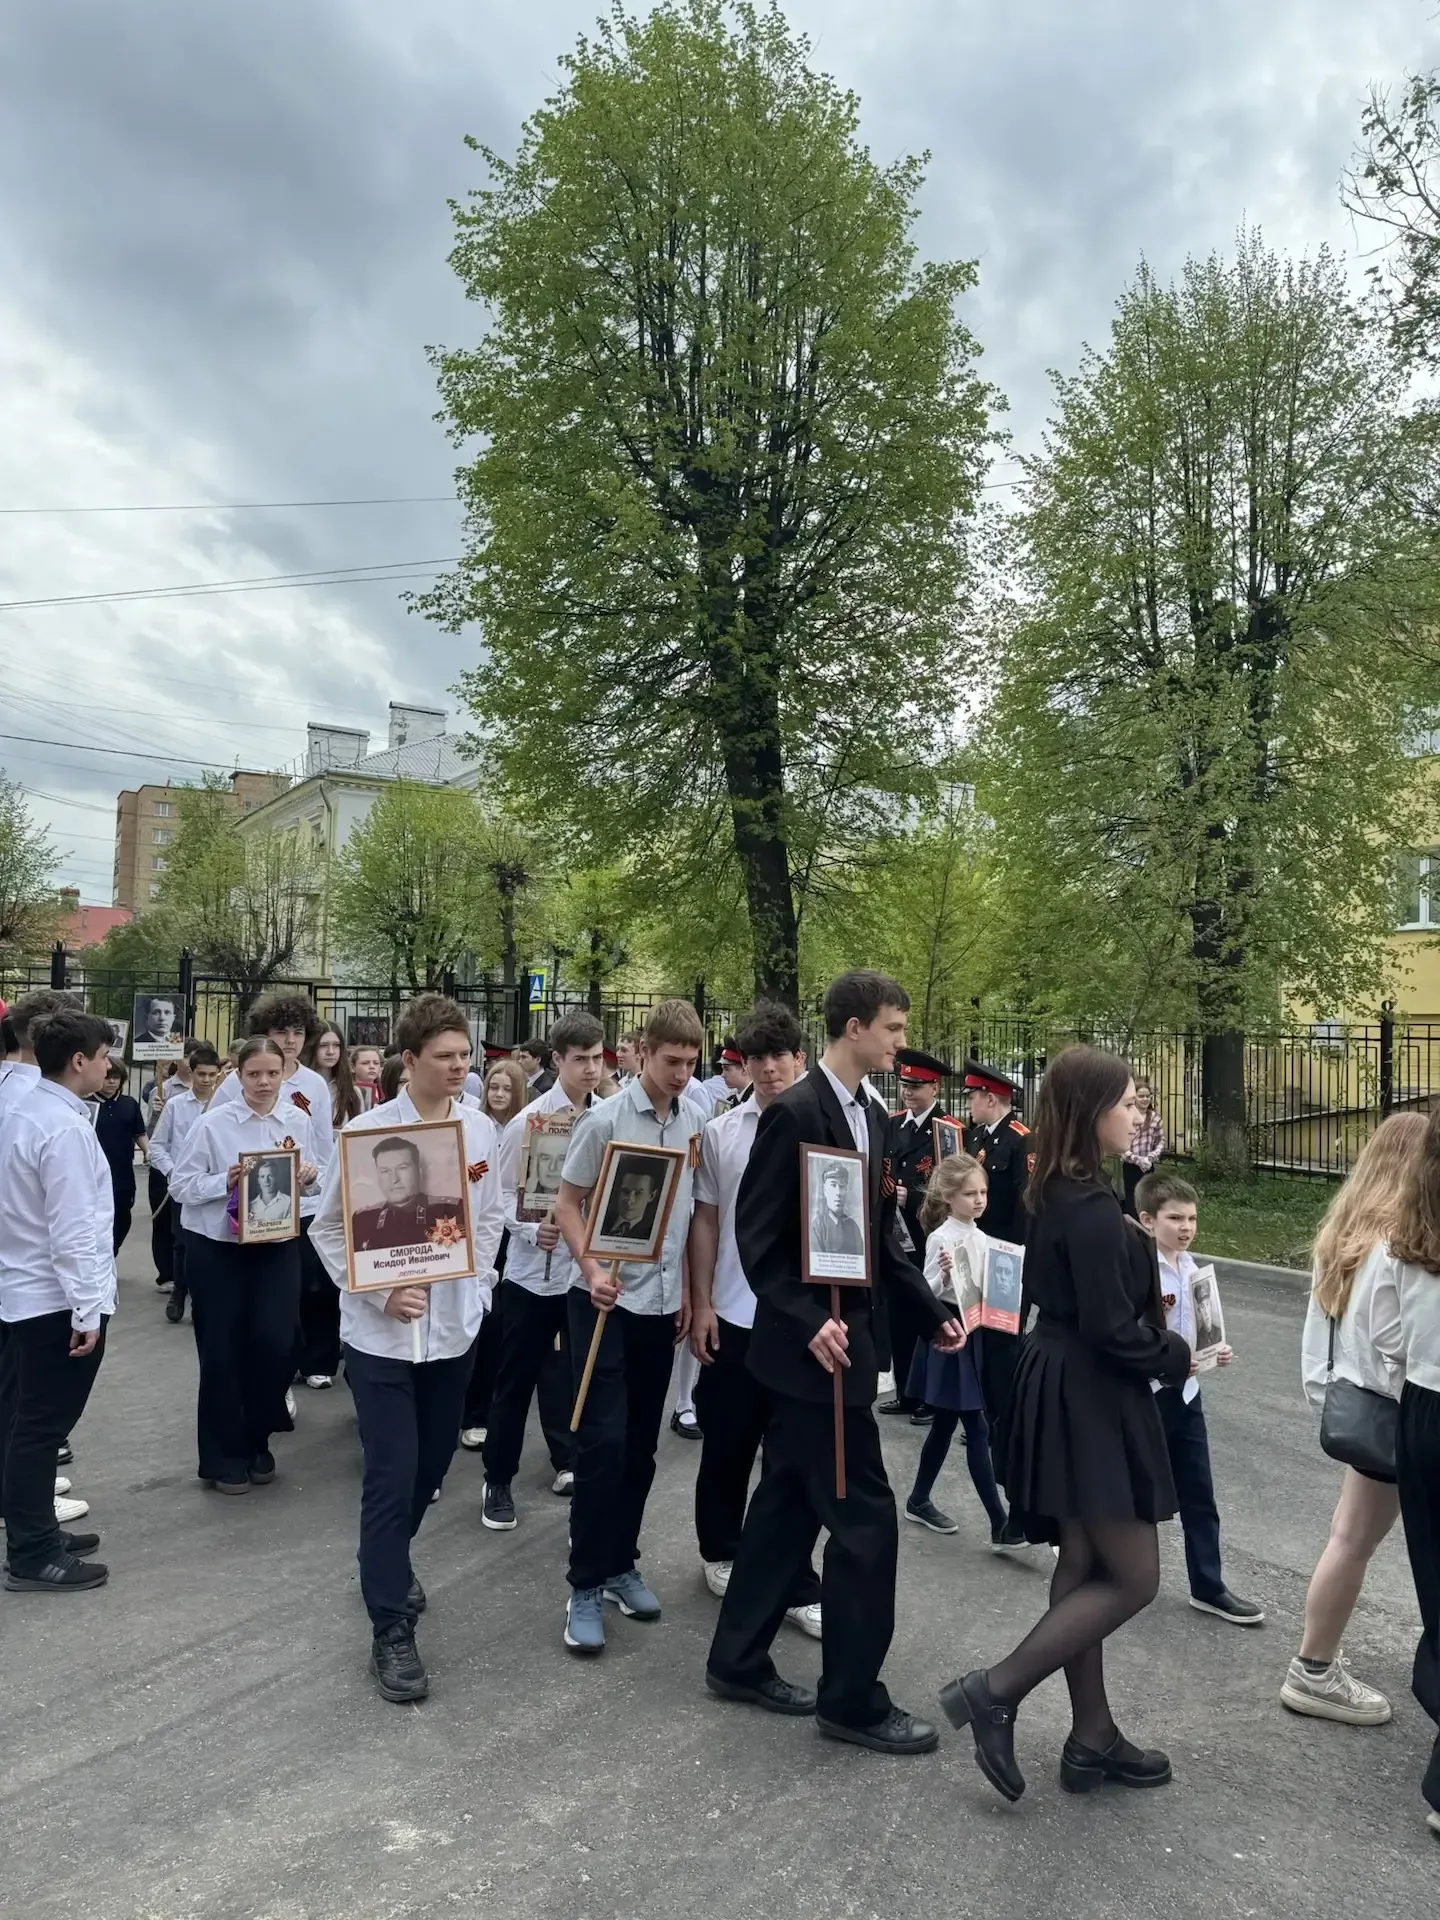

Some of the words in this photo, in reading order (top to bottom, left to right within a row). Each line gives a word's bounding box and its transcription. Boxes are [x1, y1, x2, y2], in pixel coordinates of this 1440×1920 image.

[548, 1127, 570, 1135] ПОЛК
[389, 1244, 433, 1258] СМОРОДА
[373, 1257, 407, 1269] Исидор
[408, 1252, 450, 1265] Иванович
